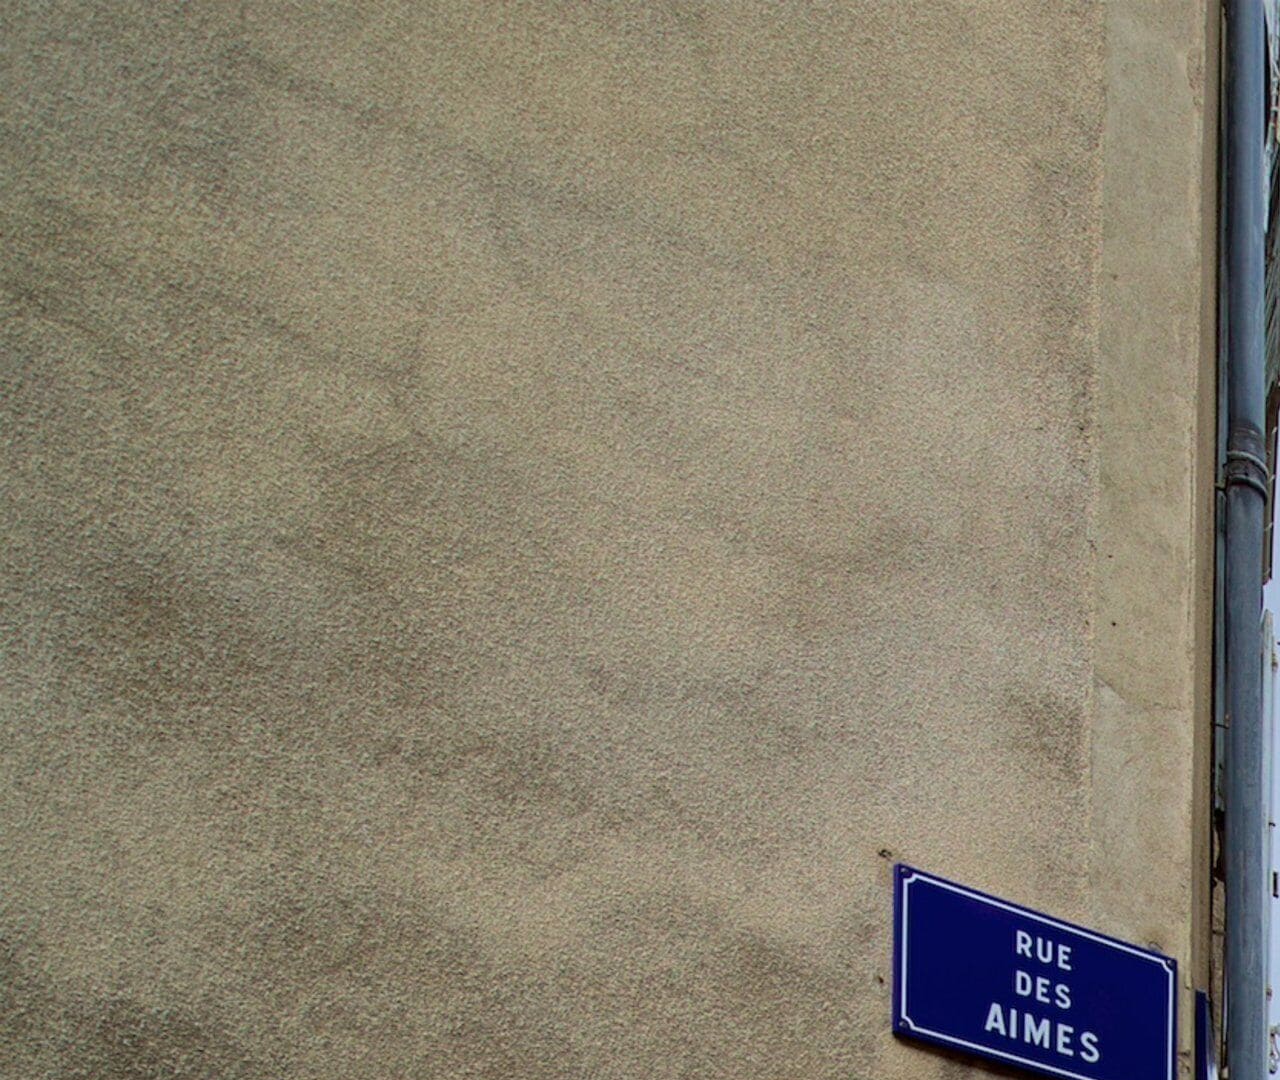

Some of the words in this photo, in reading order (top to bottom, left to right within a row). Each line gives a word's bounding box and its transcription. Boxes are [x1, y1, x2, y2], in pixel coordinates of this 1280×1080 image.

[1016, 930, 1072, 971] RUE
[1015, 970, 1072, 1010] DES
[984, 1002, 1100, 1063] AIMES
